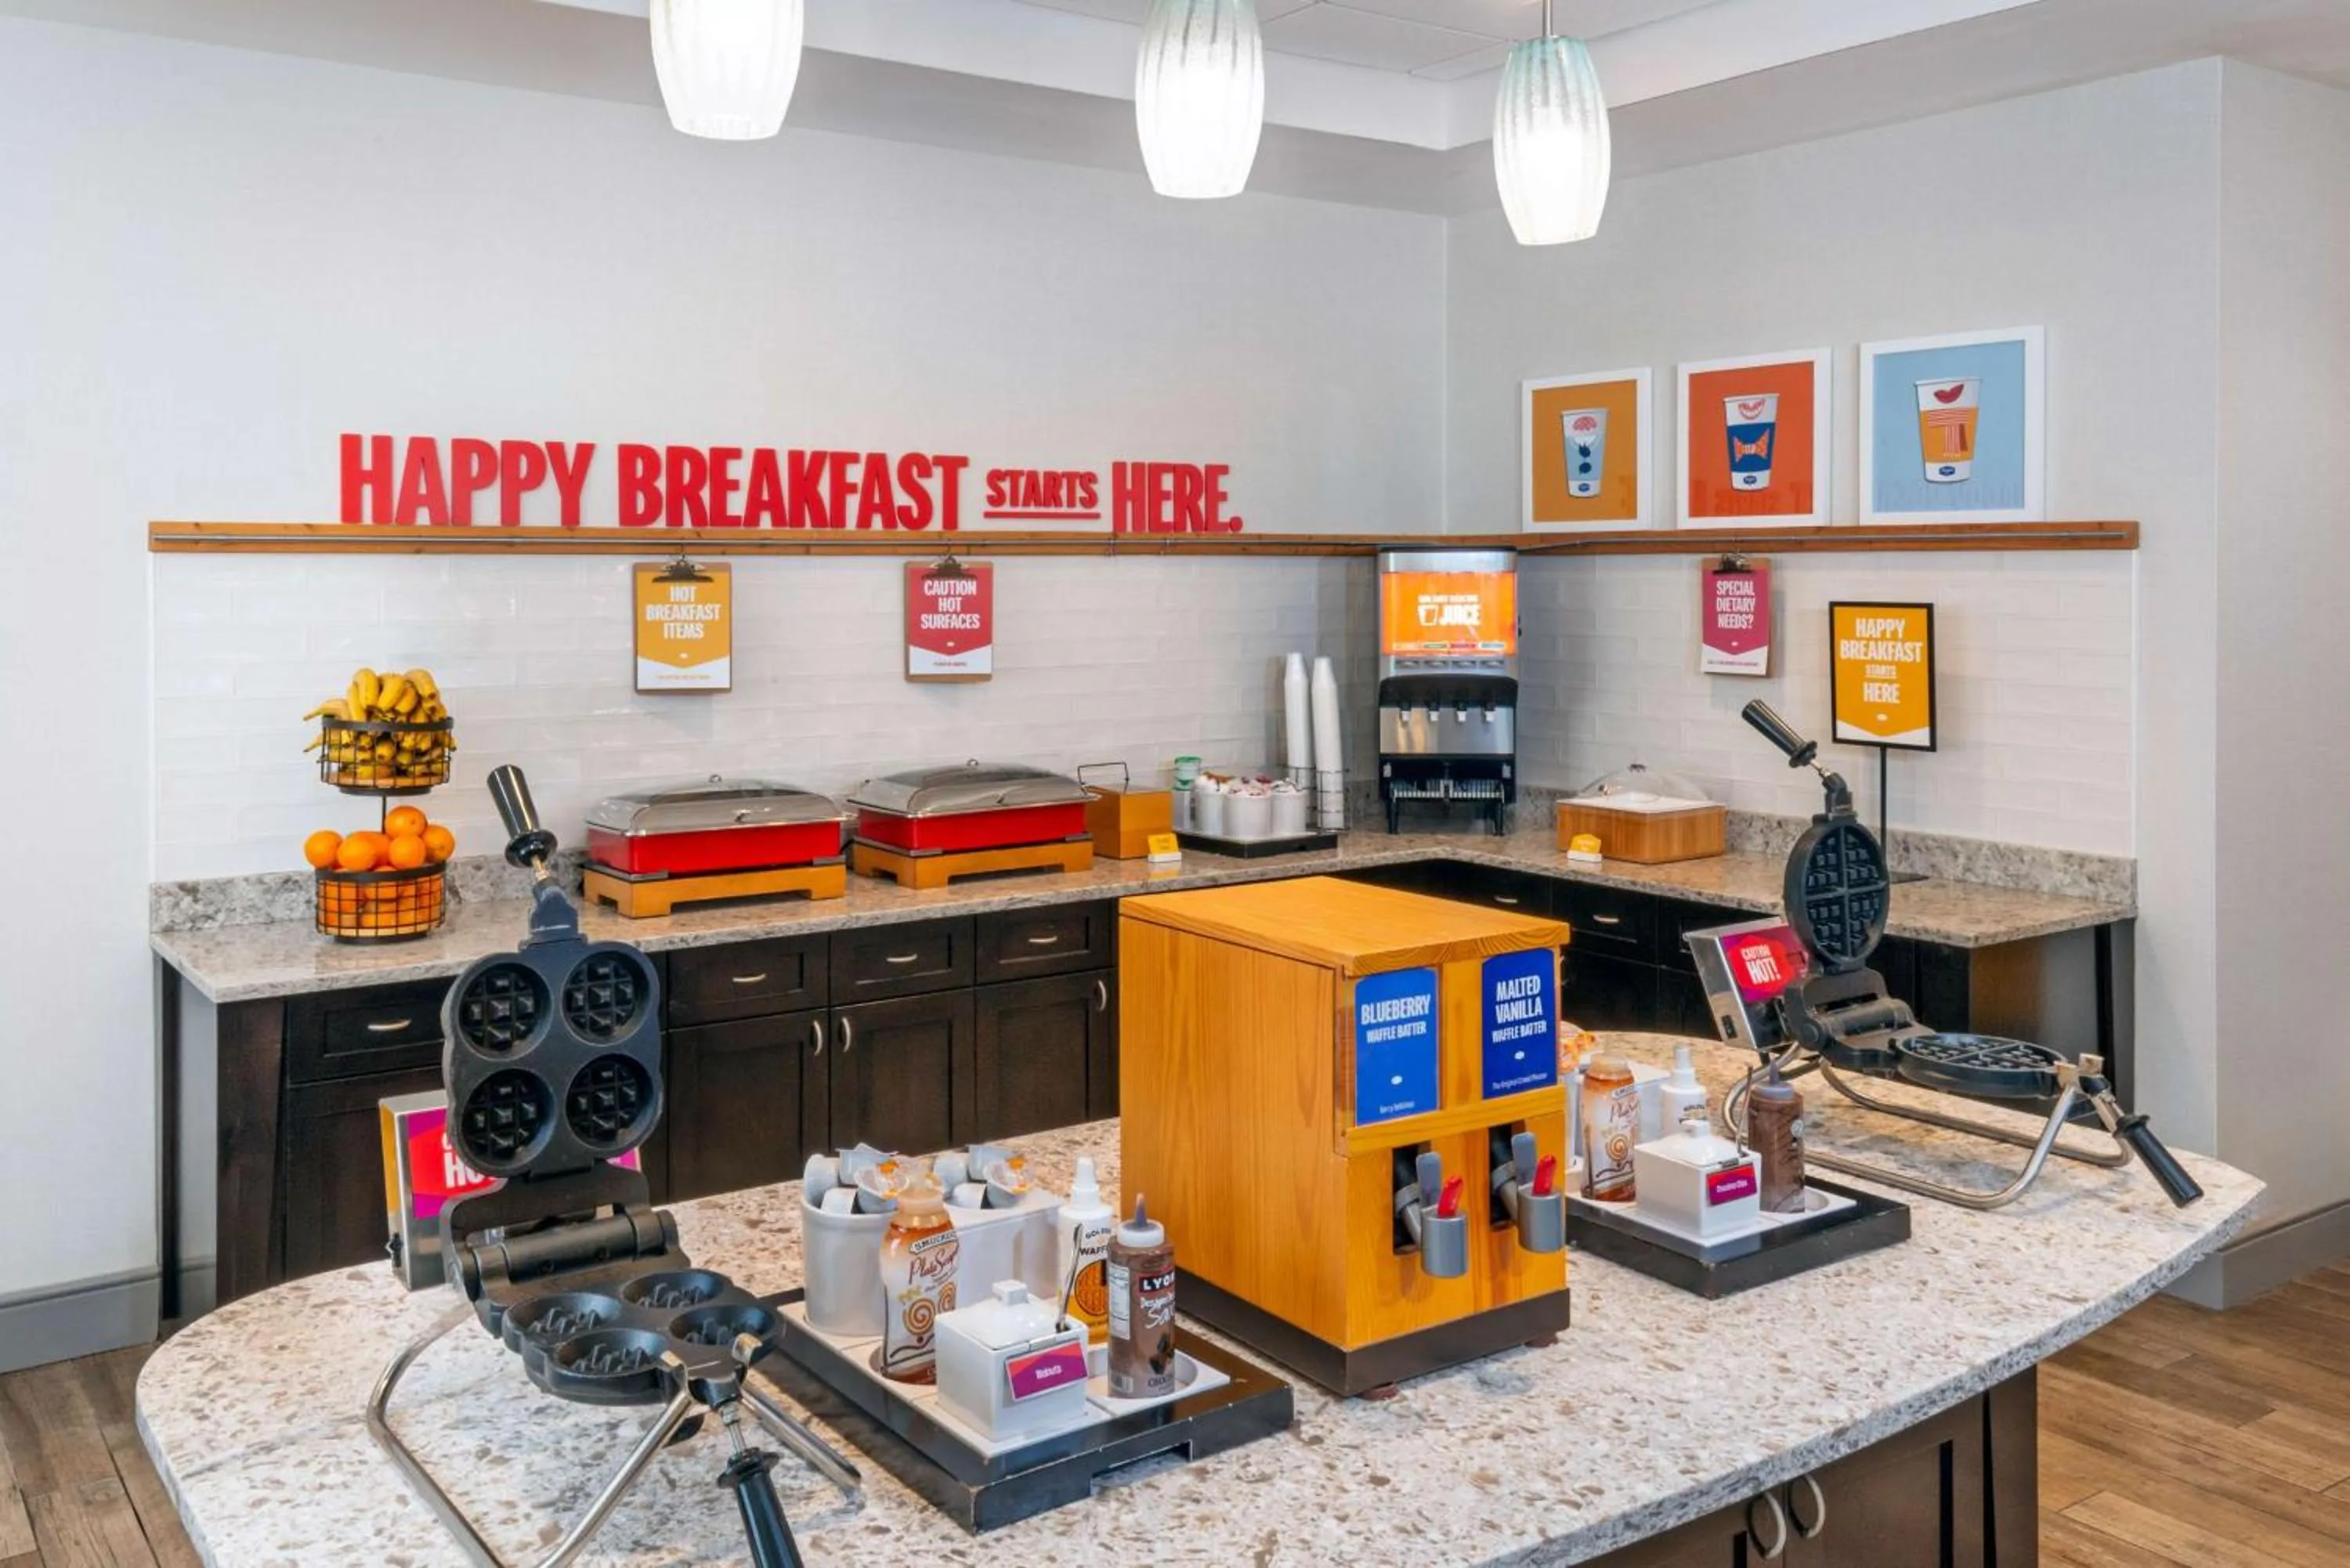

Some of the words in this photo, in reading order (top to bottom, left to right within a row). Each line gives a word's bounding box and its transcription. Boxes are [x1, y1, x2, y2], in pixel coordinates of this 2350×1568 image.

[340, 433, 596, 527] HAPPY
[617, 444, 969, 530] BREAKFAST
[985, 469, 1099, 509] STARTS
[1112, 461, 1244, 533] HERE.
[670, 585, 697, 602] HOT
[924, 580, 977, 596] CAUTION
[1716, 580, 1755, 596] SPECIAL
[645, 603, 721, 621] BREAKFAST
[938, 597, 962, 612] HOT
[1716, 597, 1755, 612] DIETARY
[663, 623, 704, 640] ITEMS
[920, 613, 981, 630] SURFACES
[1718, 613, 1755, 629] NEEDS?
[1855, 617, 1906, 638] HAPPY
[1840, 639, 1923, 663] BREAKFAST
[1863, 681, 1901, 704] HERE
[1745, 956, 1781, 985] HOT!
[1496, 975, 1541, 1002] MALTED
[1361, 993, 1431, 1026] BLUEBERRY
[1495, 996, 1543, 1024] VANILLA
[1366, 1026, 1397, 1044] WAFFLE
[1397, 1021, 1427, 1039] BATTER
[1491, 1025, 1519, 1044] WAFFLE
[1520, 1020, 1547, 1038] BATTER
